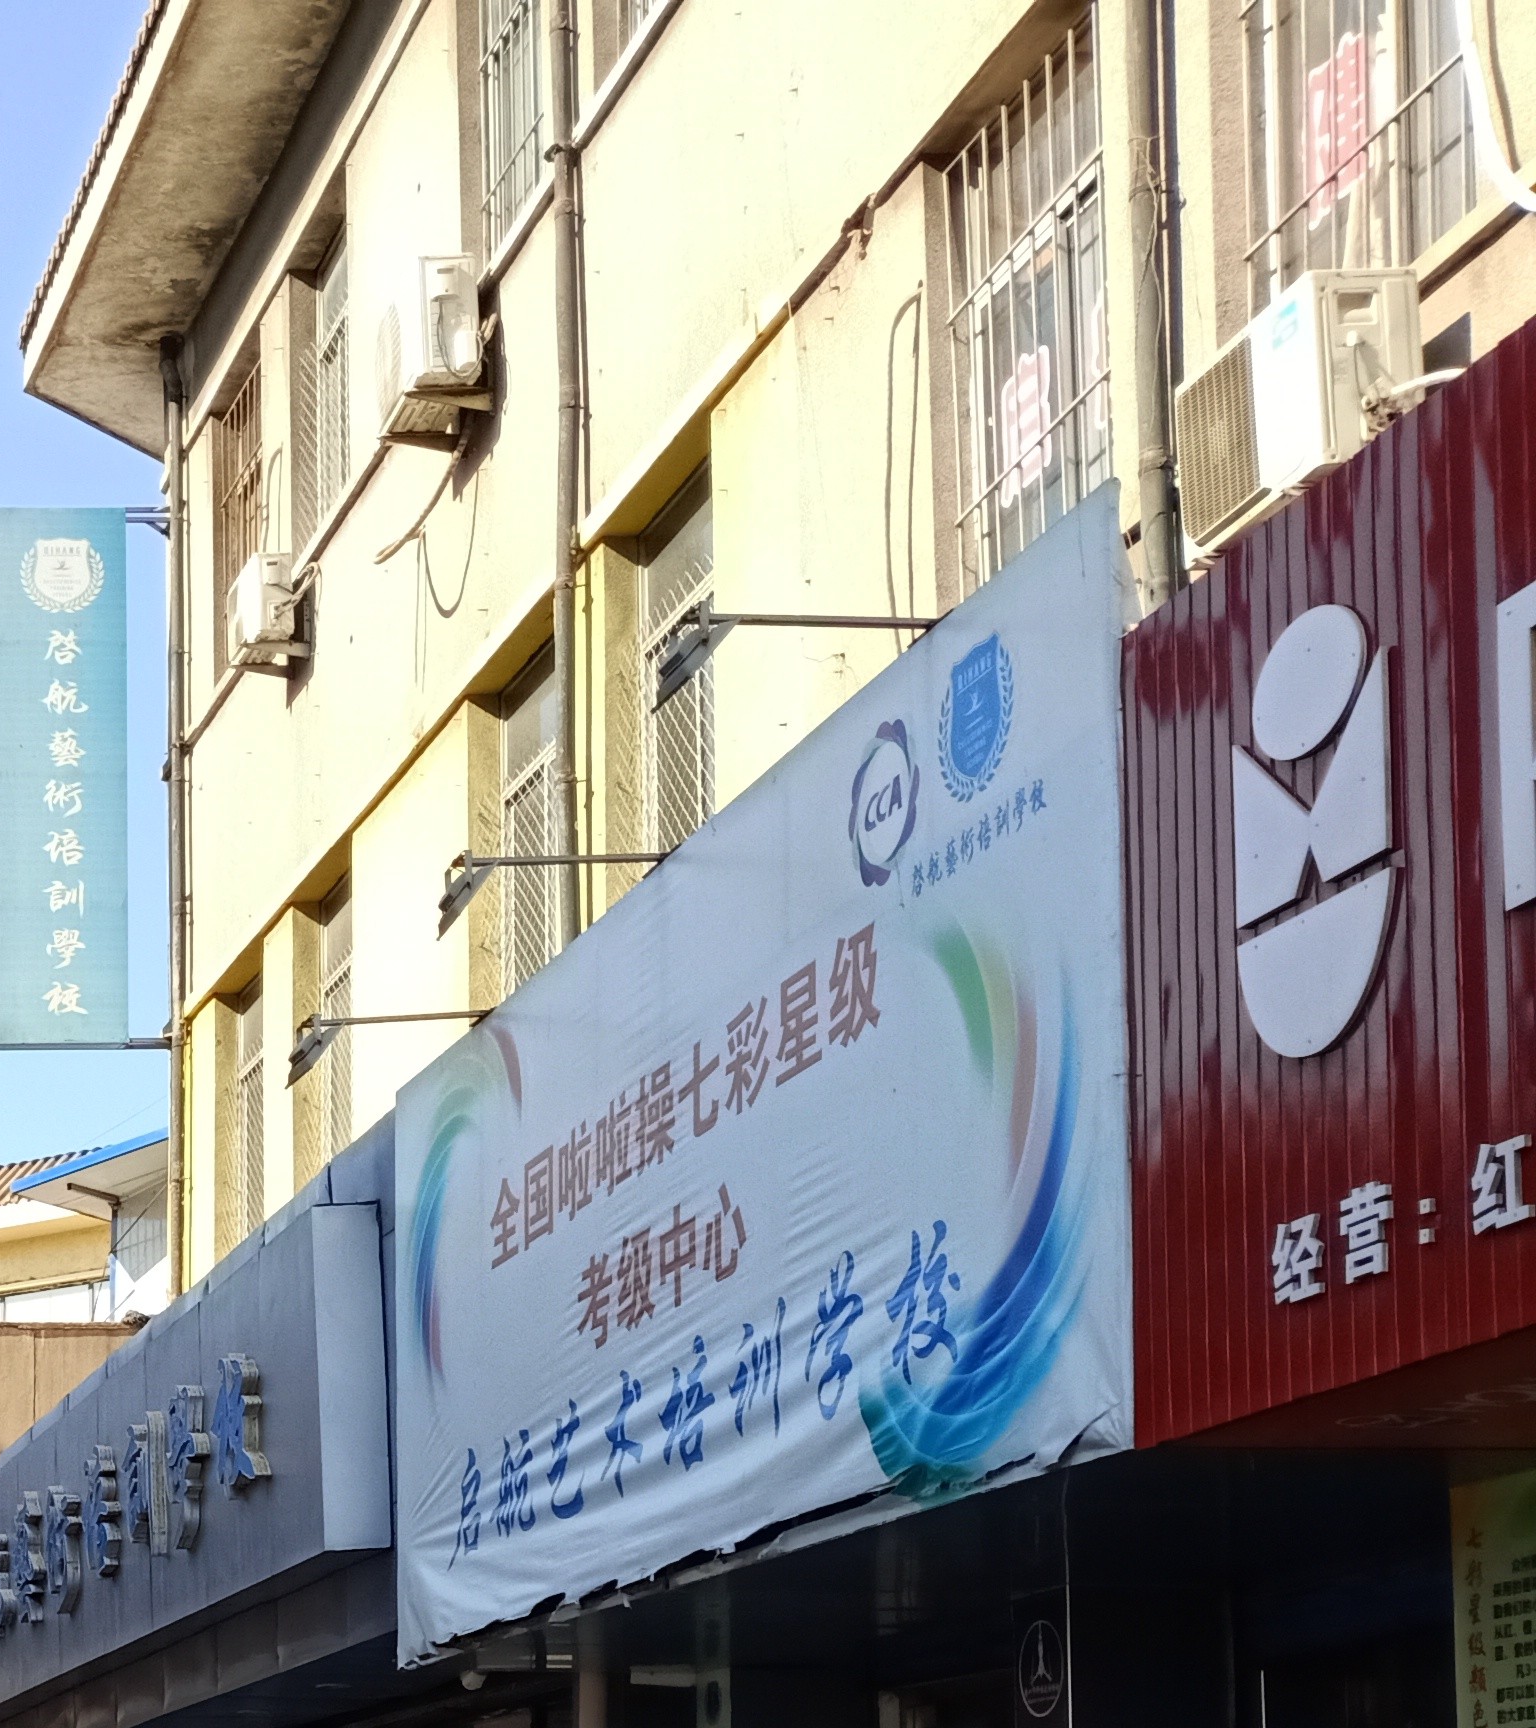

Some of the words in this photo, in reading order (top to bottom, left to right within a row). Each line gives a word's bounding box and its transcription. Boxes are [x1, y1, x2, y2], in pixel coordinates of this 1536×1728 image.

[864, 774, 903, 833] CCA
[489, 921, 881, 1270] 全国啦啦操七彩星级
[576, 1183, 747, 1348] 考级中心
[447, 1220, 961, 1571] 启航艺术培训学校
